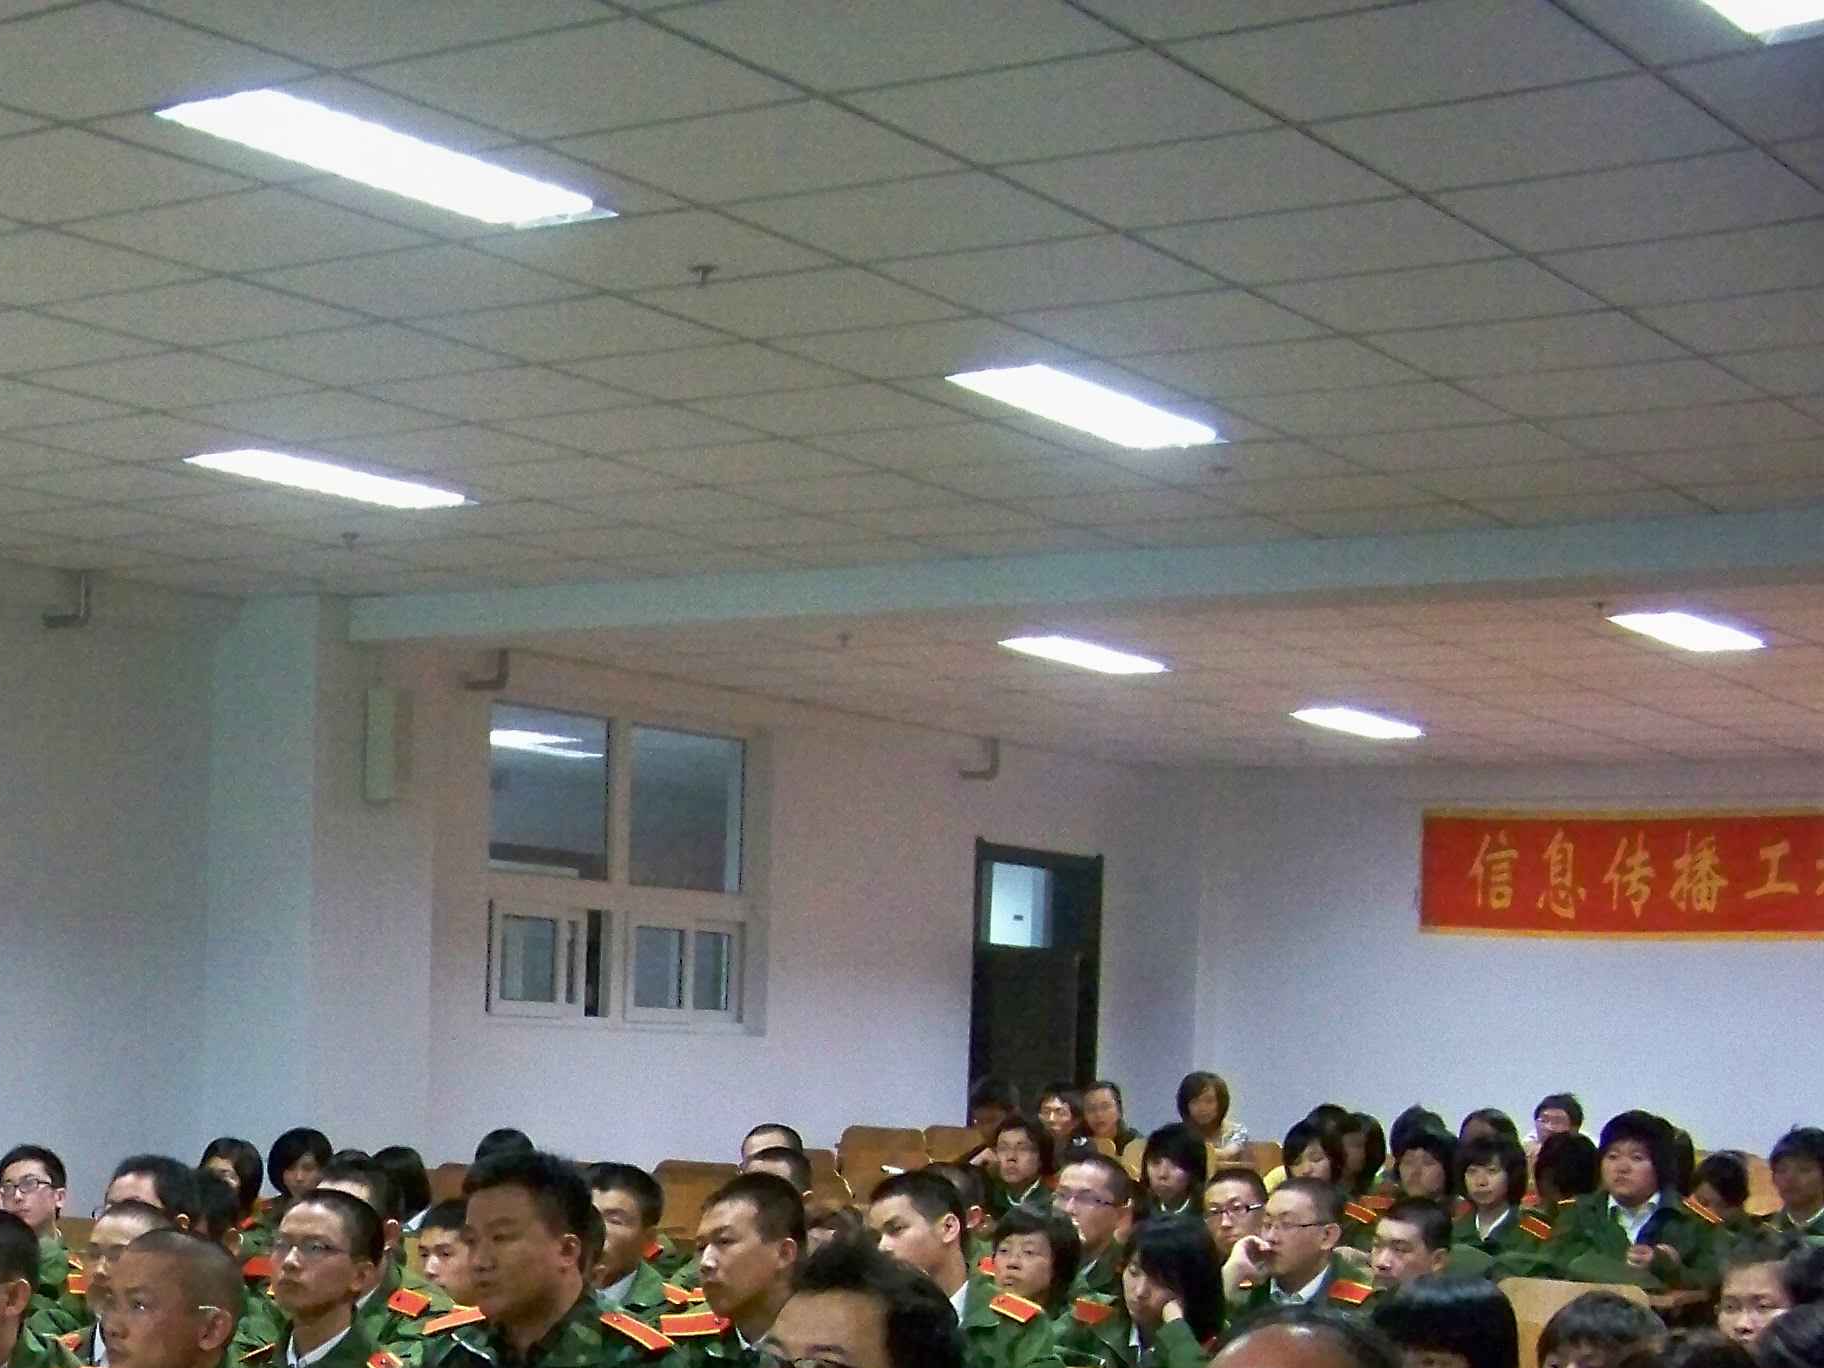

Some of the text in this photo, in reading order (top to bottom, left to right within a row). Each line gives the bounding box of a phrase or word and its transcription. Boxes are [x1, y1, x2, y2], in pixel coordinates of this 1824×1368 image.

[1468, 830, 1824, 919] 信息传播工
